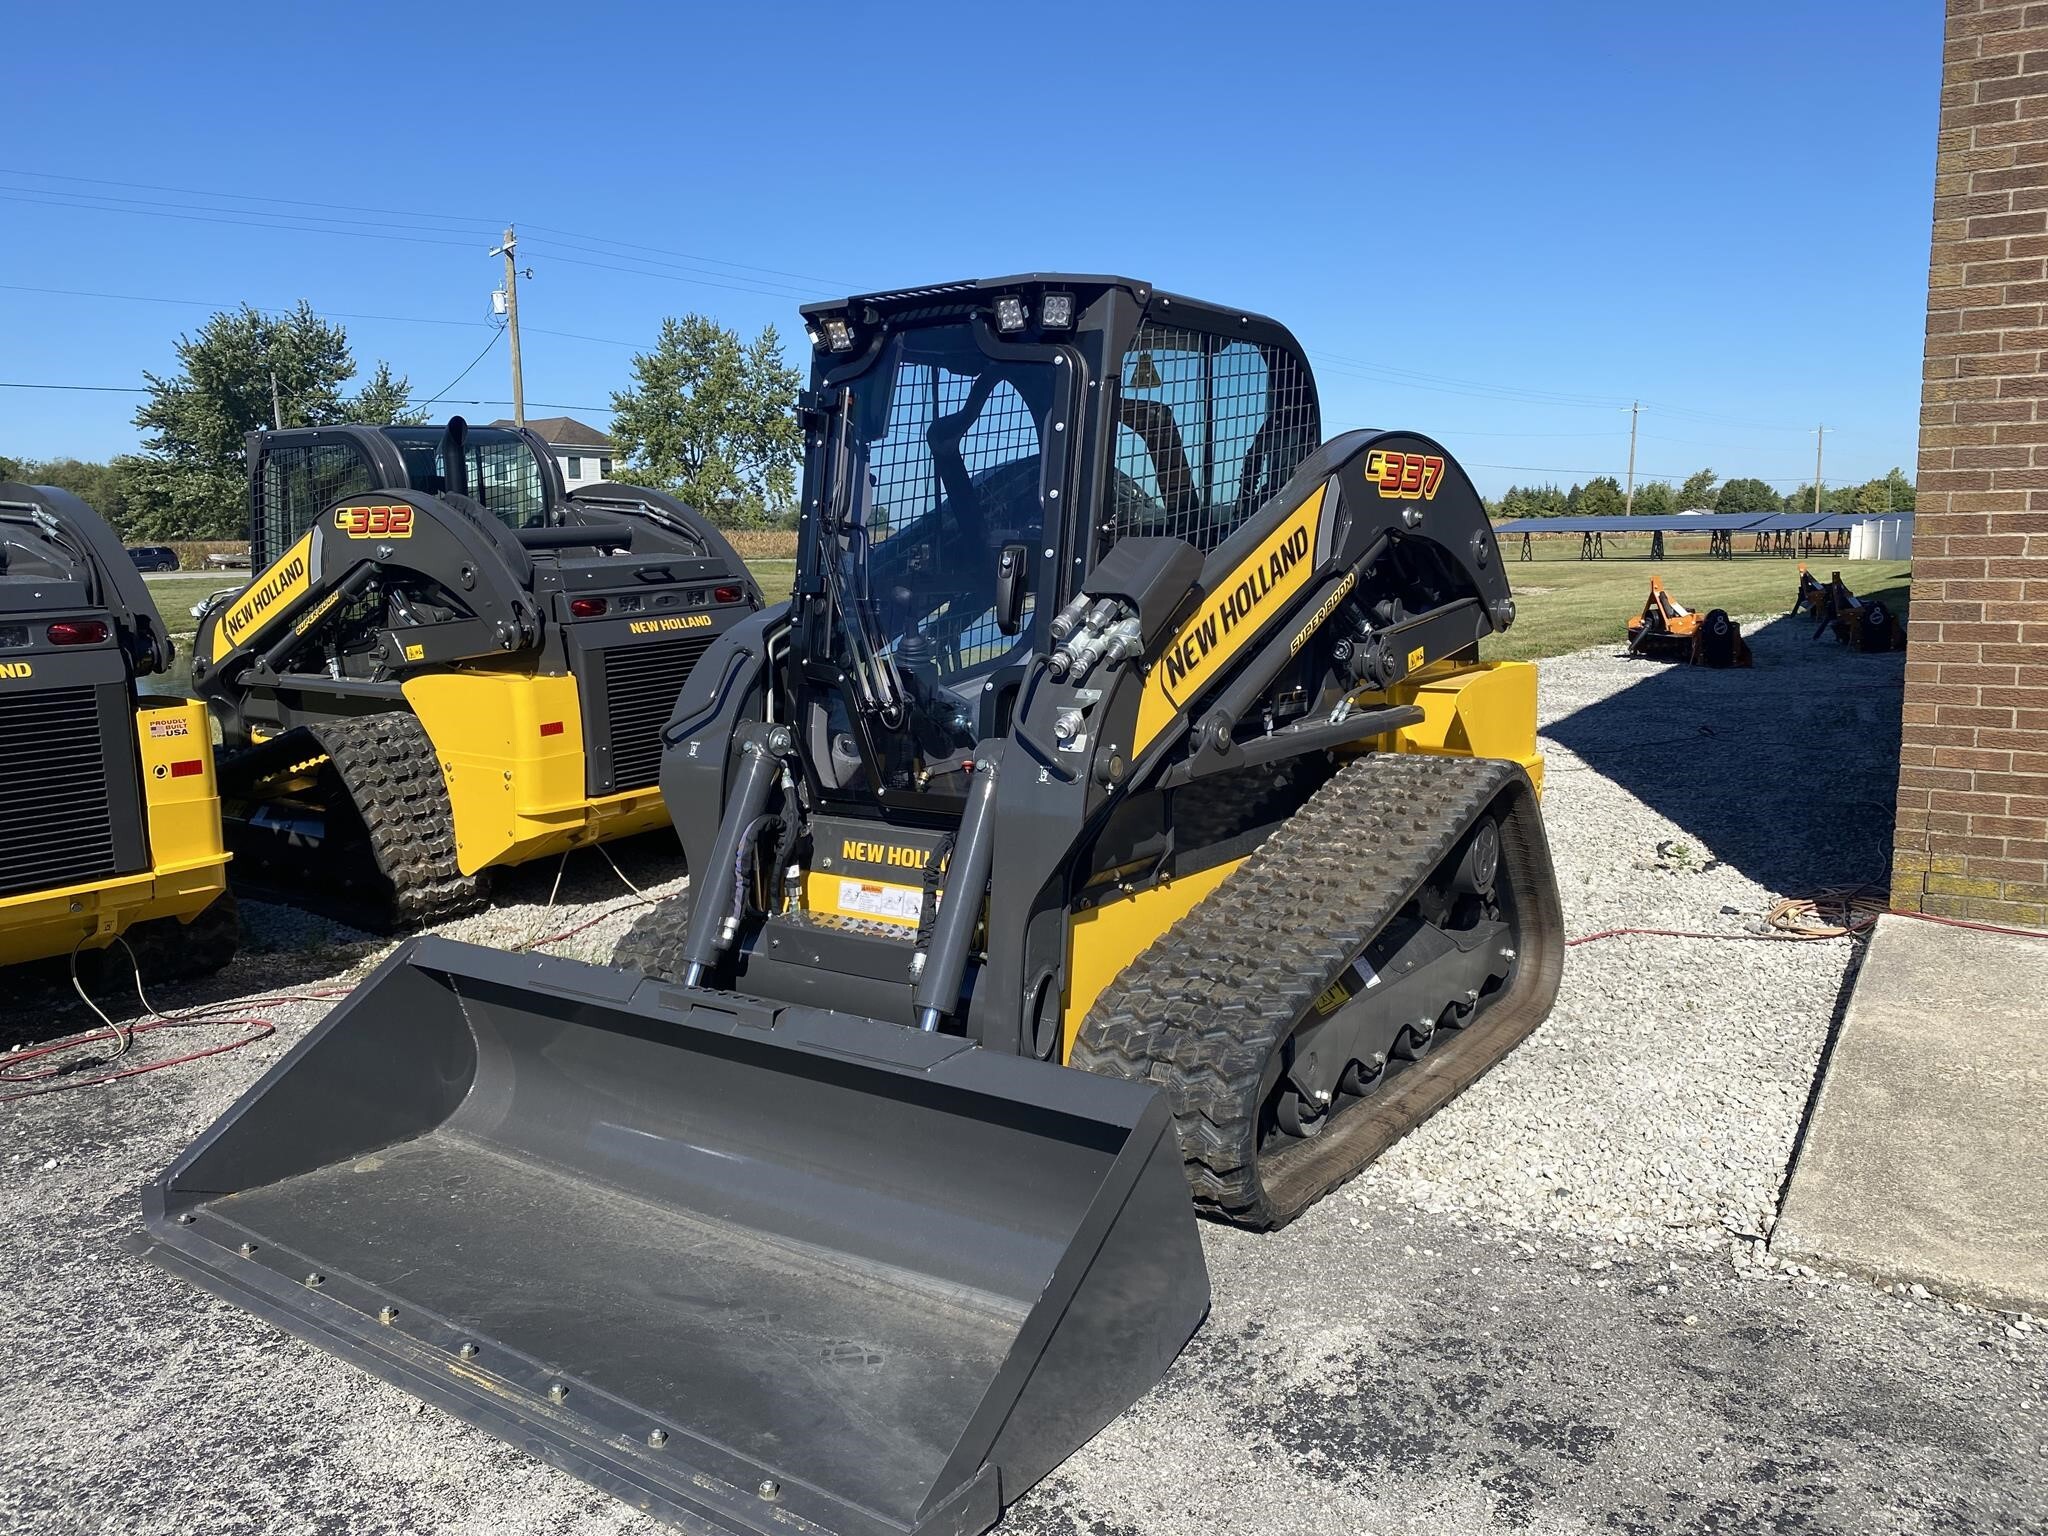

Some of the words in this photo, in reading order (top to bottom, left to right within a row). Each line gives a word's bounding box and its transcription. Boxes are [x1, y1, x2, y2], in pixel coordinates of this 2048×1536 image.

[1365, 450, 1445, 500] C337
[334, 505, 414, 538] C332
[228, 602, 254, 636] NEW
[253, 557, 304, 614] HOLLAND
[1165, 612, 1217, 689] NEW
[1219, 525, 1308, 635] HOLLAND
[630, 620, 659, 634] NEW
[659, 615, 712, 631] HOLLAND
[1291, 608, 1326, 656] SUPER
[1325, 572, 1355, 613] BOOM
[150, 718, 187, 726] PROUDLY
[166, 729, 189, 737] USA
[842, 840, 885, 864] NEW
